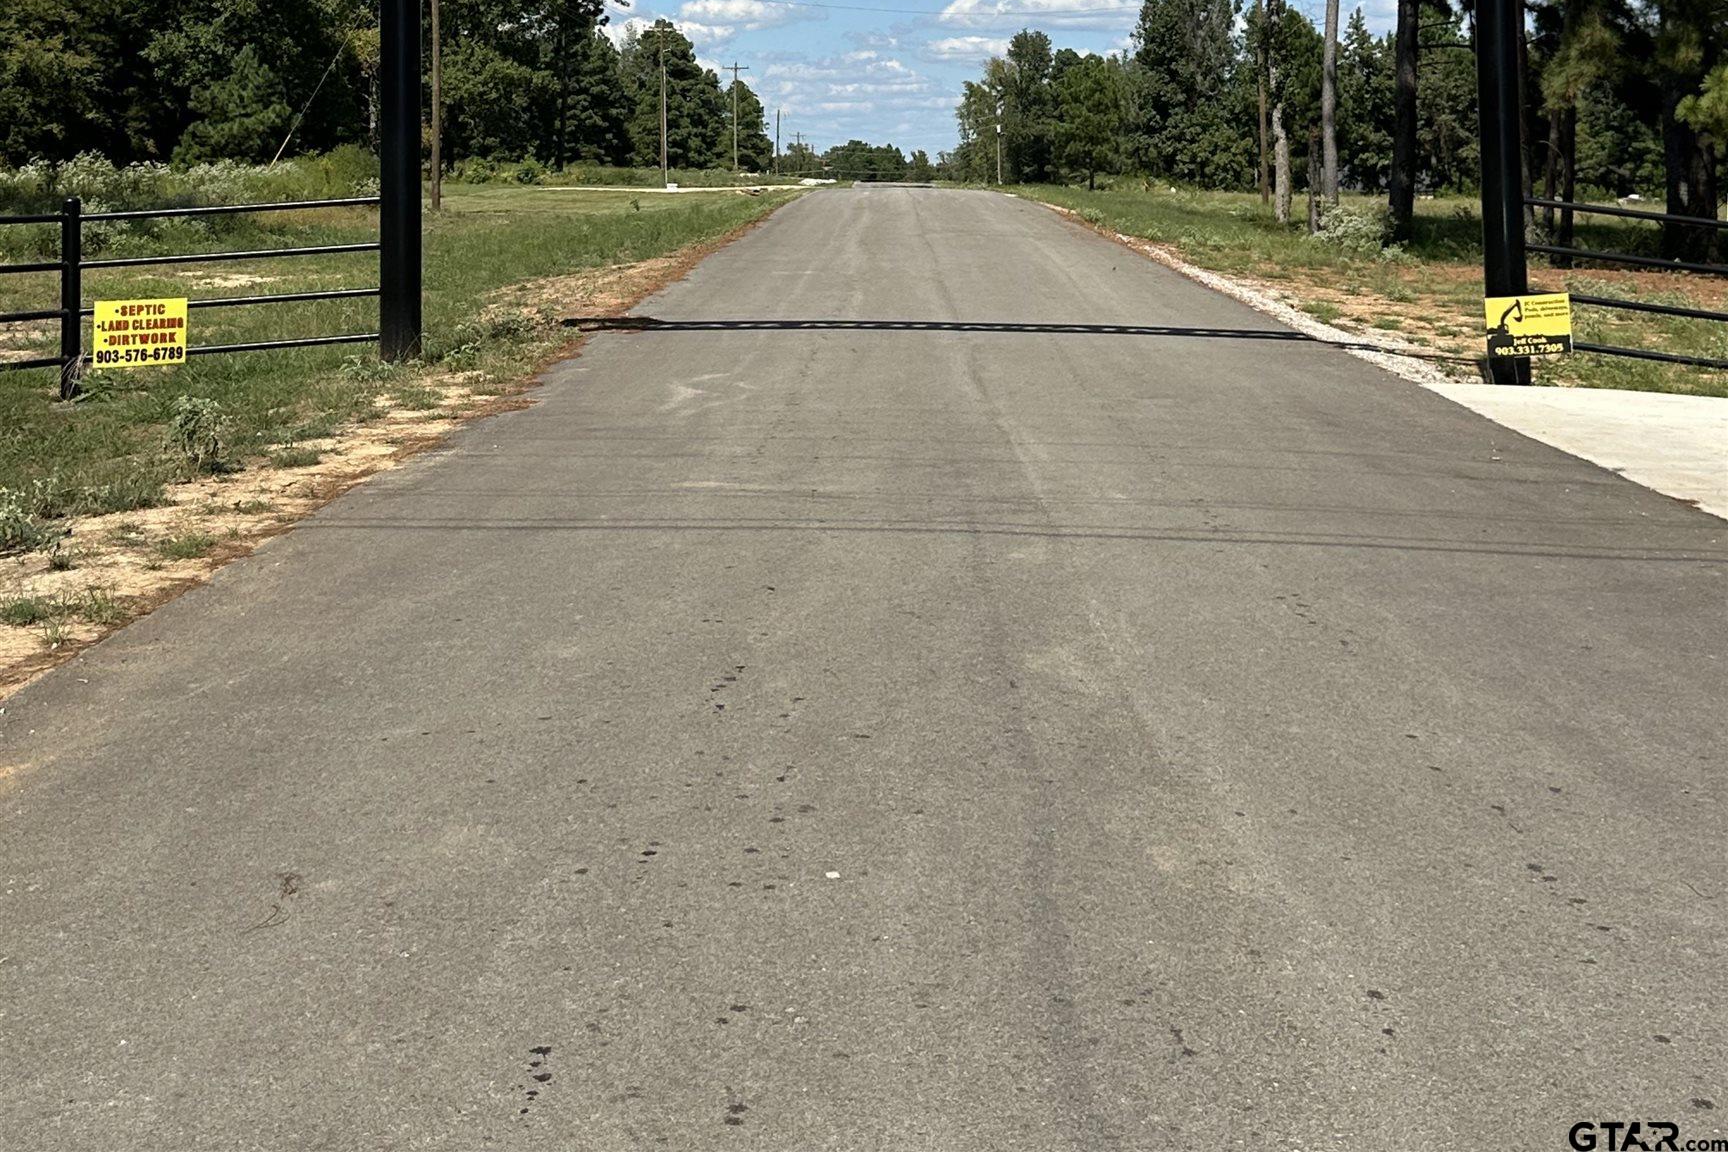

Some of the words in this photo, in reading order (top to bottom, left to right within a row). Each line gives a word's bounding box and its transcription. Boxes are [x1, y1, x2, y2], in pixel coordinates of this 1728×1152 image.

[120, 304, 166, 316] SEPTIC
[101, 320, 130, 332] LAND
[132, 317, 184, 330] CLEARING
[108, 332, 177, 346] DIRTWORK
[96, 346, 184, 364] 903-576-6789
[1495, 343, 1564, 356] 903.331.7305
